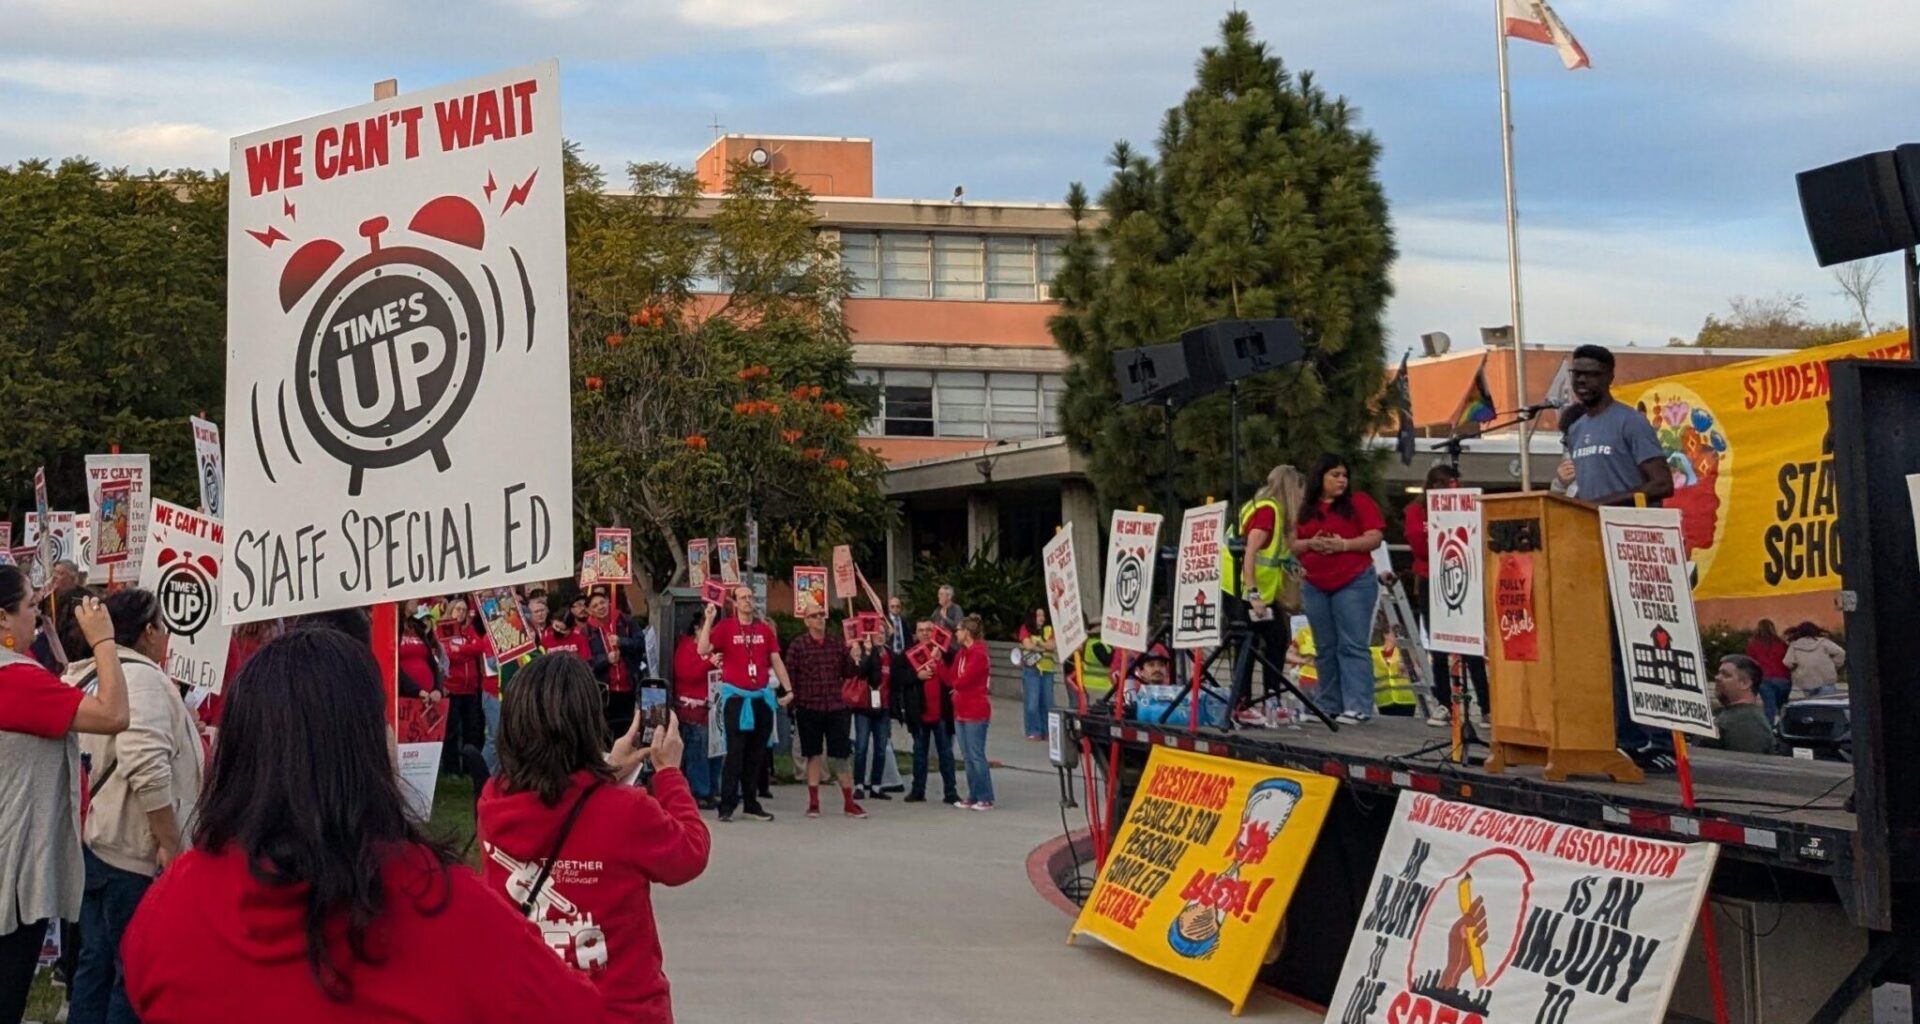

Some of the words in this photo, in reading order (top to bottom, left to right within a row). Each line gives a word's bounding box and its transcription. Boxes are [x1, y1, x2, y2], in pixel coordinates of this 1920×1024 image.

[245, 135, 304, 197] WE
[315, 106, 424, 180] CAN'T
[434, 79, 538, 152] WAIT
[332, 291, 428, 351] TIME'S
[337, 325, 447, 429] UP
[90, 468, 108, 479] WE
[110, 468, 143, 479] CAN'T
[155, 503, 174, 527] WE
[174, 511, 209, 538] CAN'T
[233, 523, 328, 613] STAFF
[340, 502, 490, 592] SPECIAL
[1181, 569, 1219, 584] SCHOOLS
[1617, 543, 1659, 562] ESCUELAS
[1660, 547, 1678, 565] CON
[1628, 563, 1672, 584] PERSONAL
[168, 592, 202, 622] UP
[169, 580, 198, 594] TIME'S
[1121, 578, 1138, 601] UP
[1629, 583, 1674, 603] COMPLETO
[1633, 601, 1641, 618] Y
[1642, 602, 1679, 623] ESTABLE
[1645, 692, 1678, 715] PODEMOS
[1146, 764, 1235, 811] NECESITAMOS
[1129, 796, 1192, 838] ESCUELAS
[1186, 807, 1222, 845] CON
[1408, 794, 1431, 824] SAN
[1429, 802, 1476, 832] DIEGO
[1469, 808, 1558, 853] EDUCATION
[1553, 827, 1686, 878] ASSOCIATION
[1121, 827, 1189, 872] PERSONAL
[1400, 838, 1430, 881] AN
[1104, 853, 1173, 900] COMPLETO
[1362, 874, 1435, 940] INJURY
[1562, 875, 1601, 916] IS
[1591, 877, 1644, 930] AN
[1366, 935, 1389, 980] TO
[1510, 906, 1660, 1003] INJURY
[1341, 976, 1387, 1024] ONE
[1535, 981, 1576, 1024] TO
